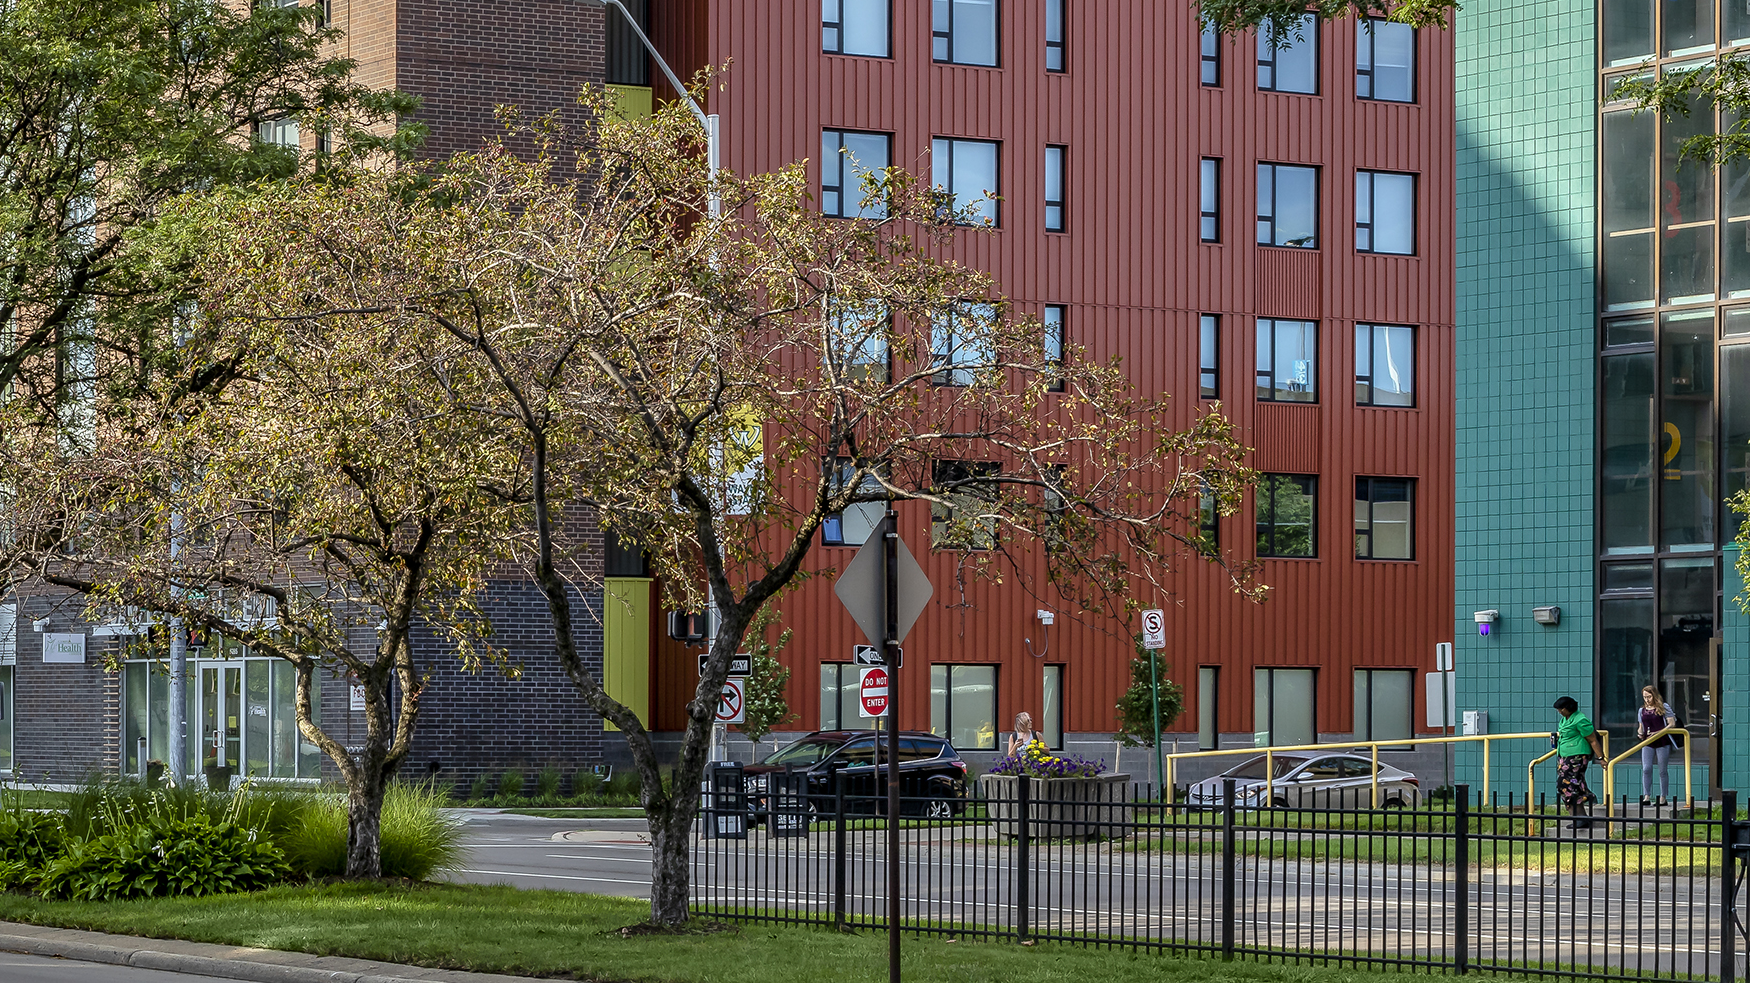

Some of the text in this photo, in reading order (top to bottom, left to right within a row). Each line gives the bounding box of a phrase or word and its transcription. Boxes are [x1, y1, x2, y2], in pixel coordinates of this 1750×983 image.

[58, 643, 82, 653] Health
[865, 677, 887, 686] DO NOT
[867, 699, 885, 707] ENTER
